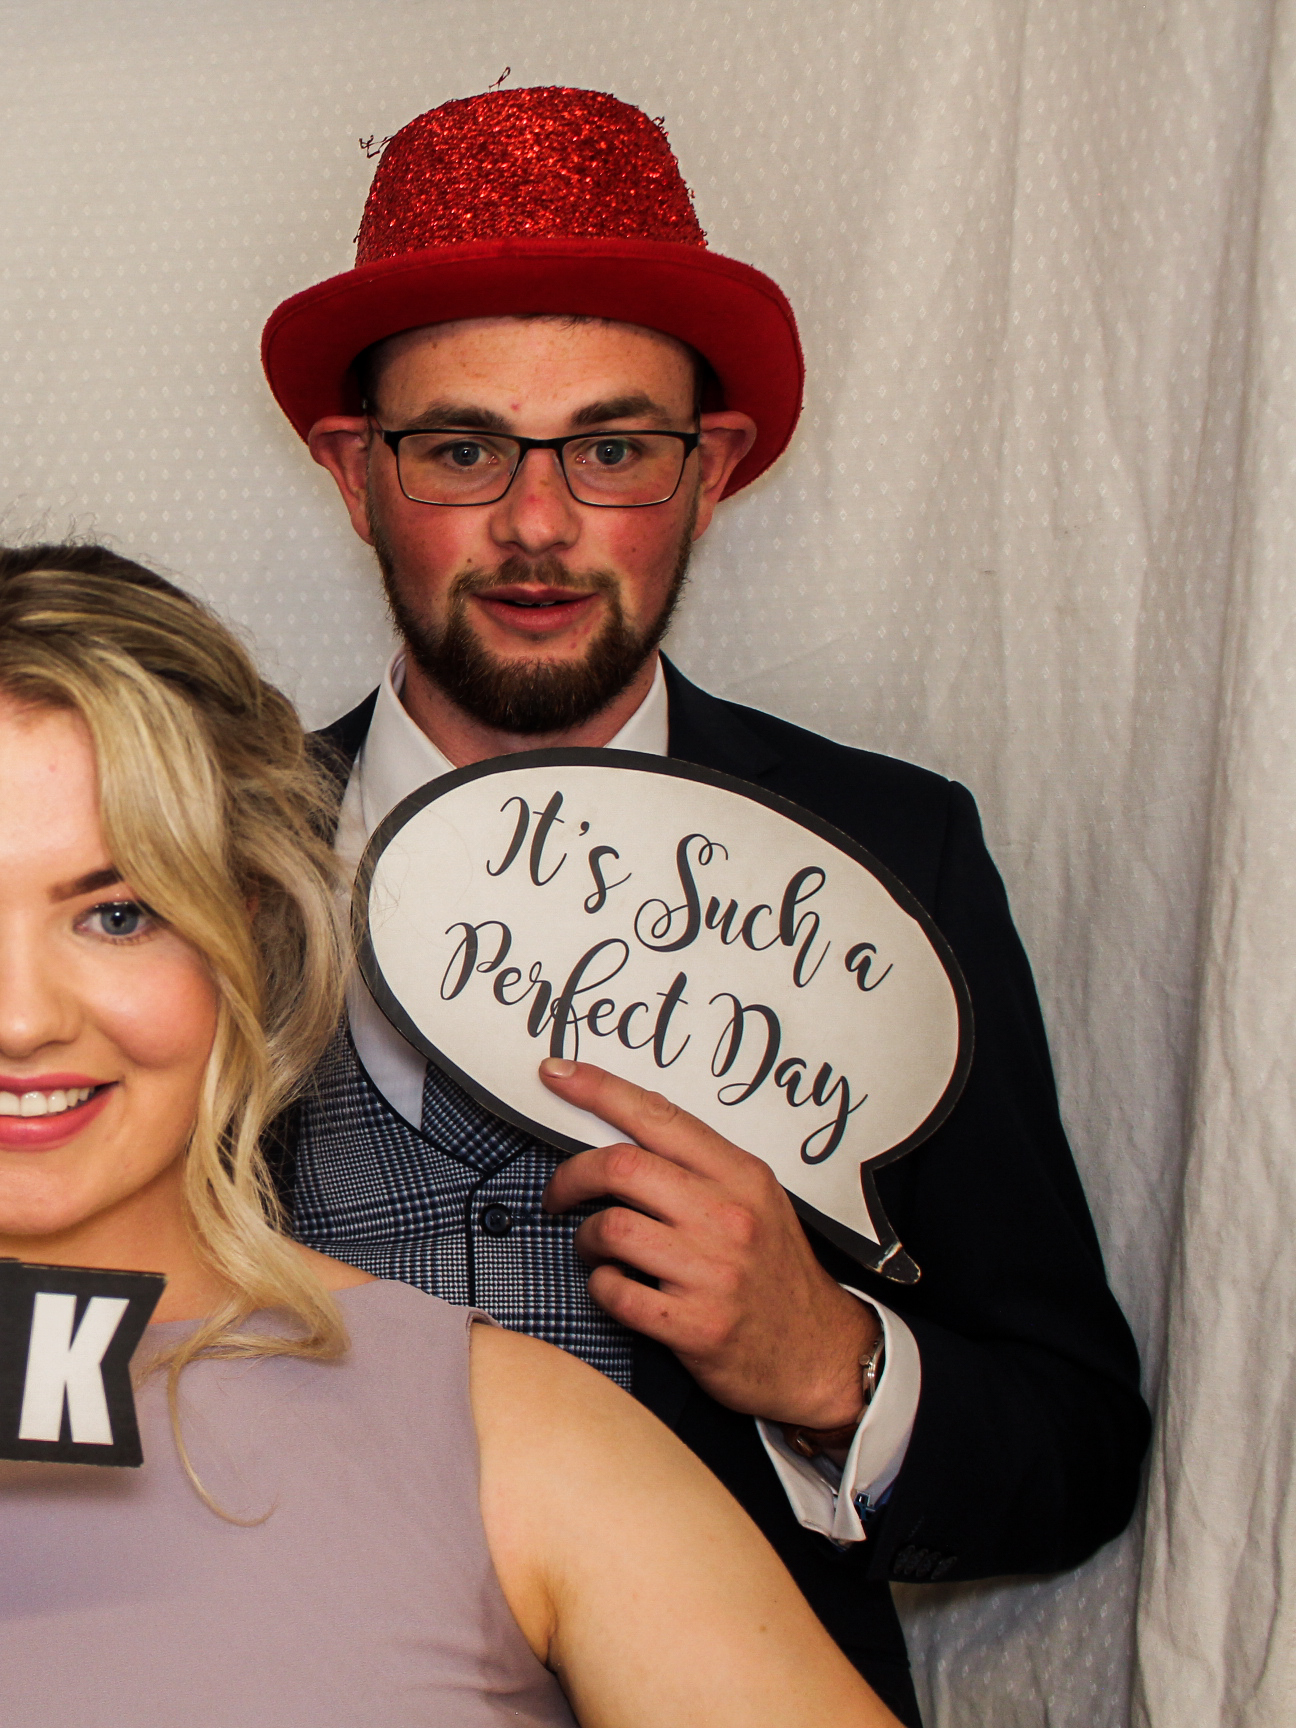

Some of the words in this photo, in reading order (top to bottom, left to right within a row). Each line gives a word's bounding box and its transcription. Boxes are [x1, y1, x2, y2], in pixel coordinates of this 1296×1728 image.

[486, 790, 632, 914] It's
[633, 832, 831, 988] Such
[844, 941, 894, 992] a
[439, 920, 692, 1069] Perfect
[708, 991, 869, 1166] Day
